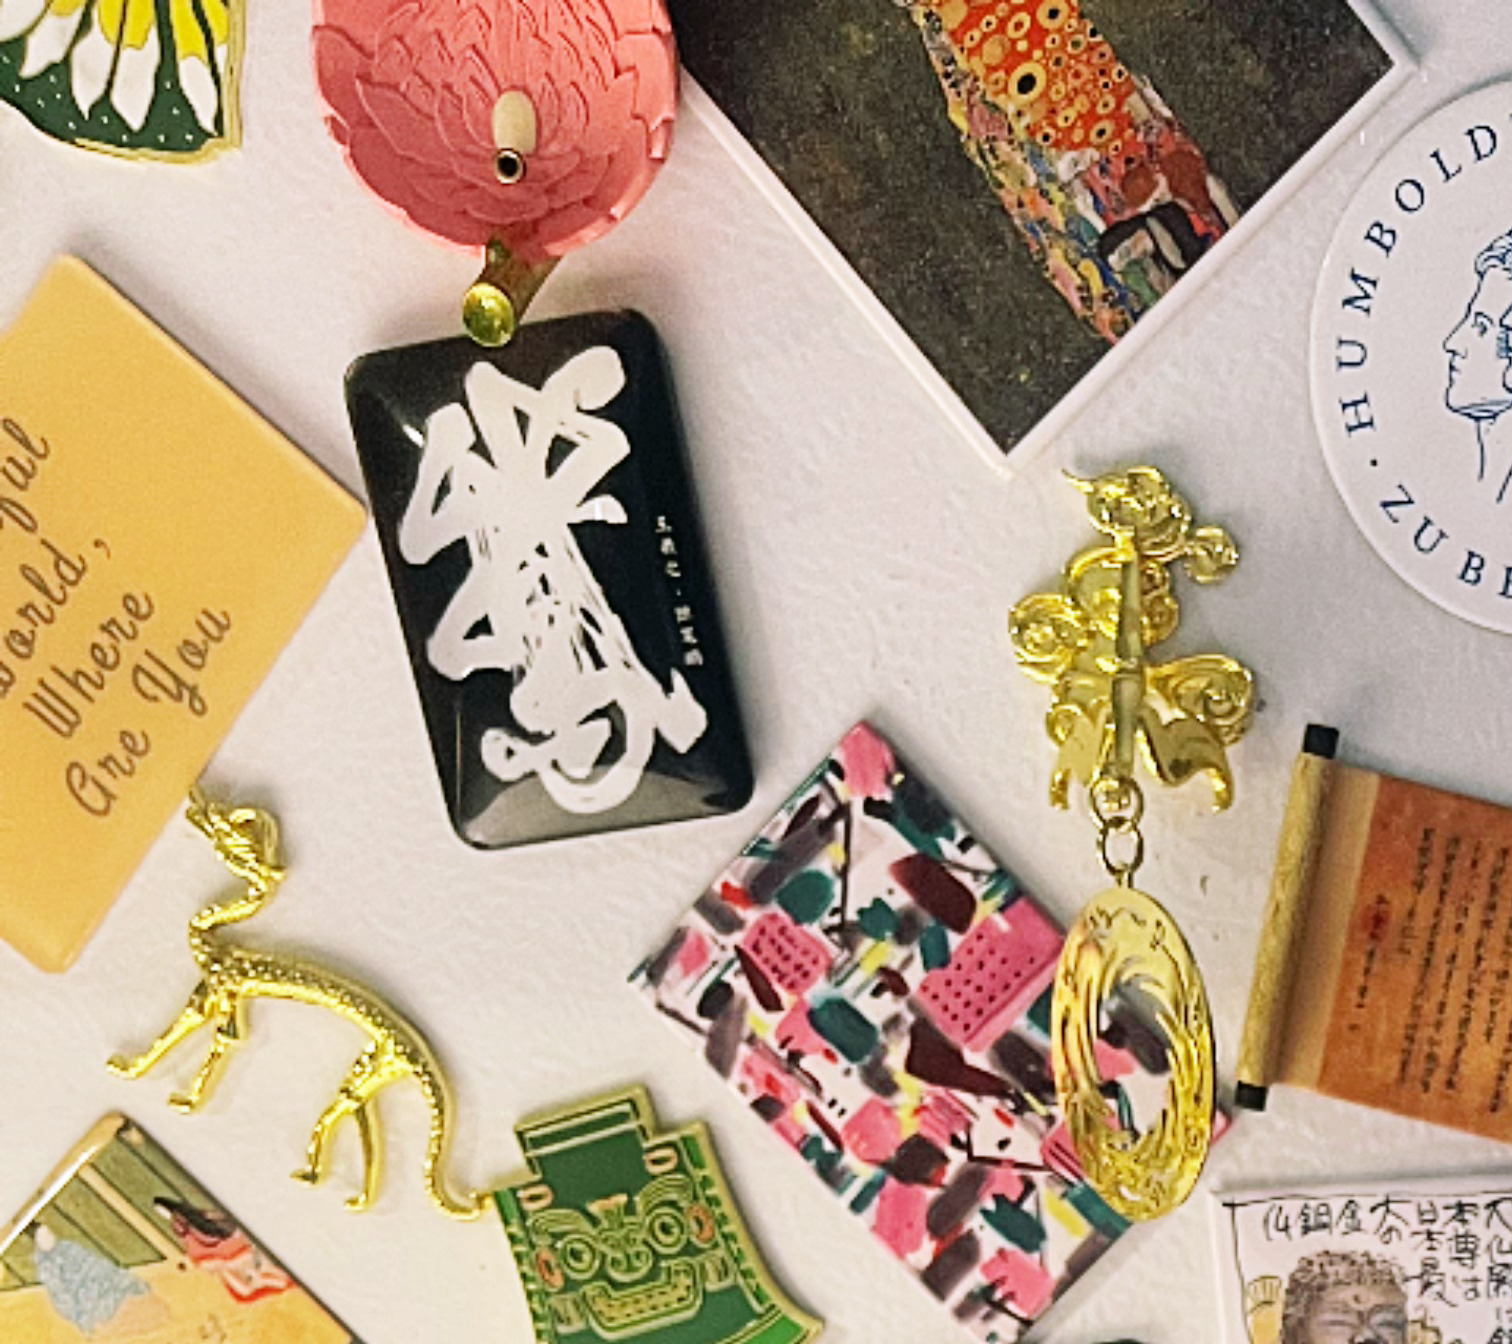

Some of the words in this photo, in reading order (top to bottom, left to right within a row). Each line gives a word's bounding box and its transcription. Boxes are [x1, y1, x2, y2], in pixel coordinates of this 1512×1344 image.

[1378, 484, 1450, 556] ZU
[22, 591, 155, 741] Where
[65, 729, 151, 818] Are
[131, 608, 232, 719] You
